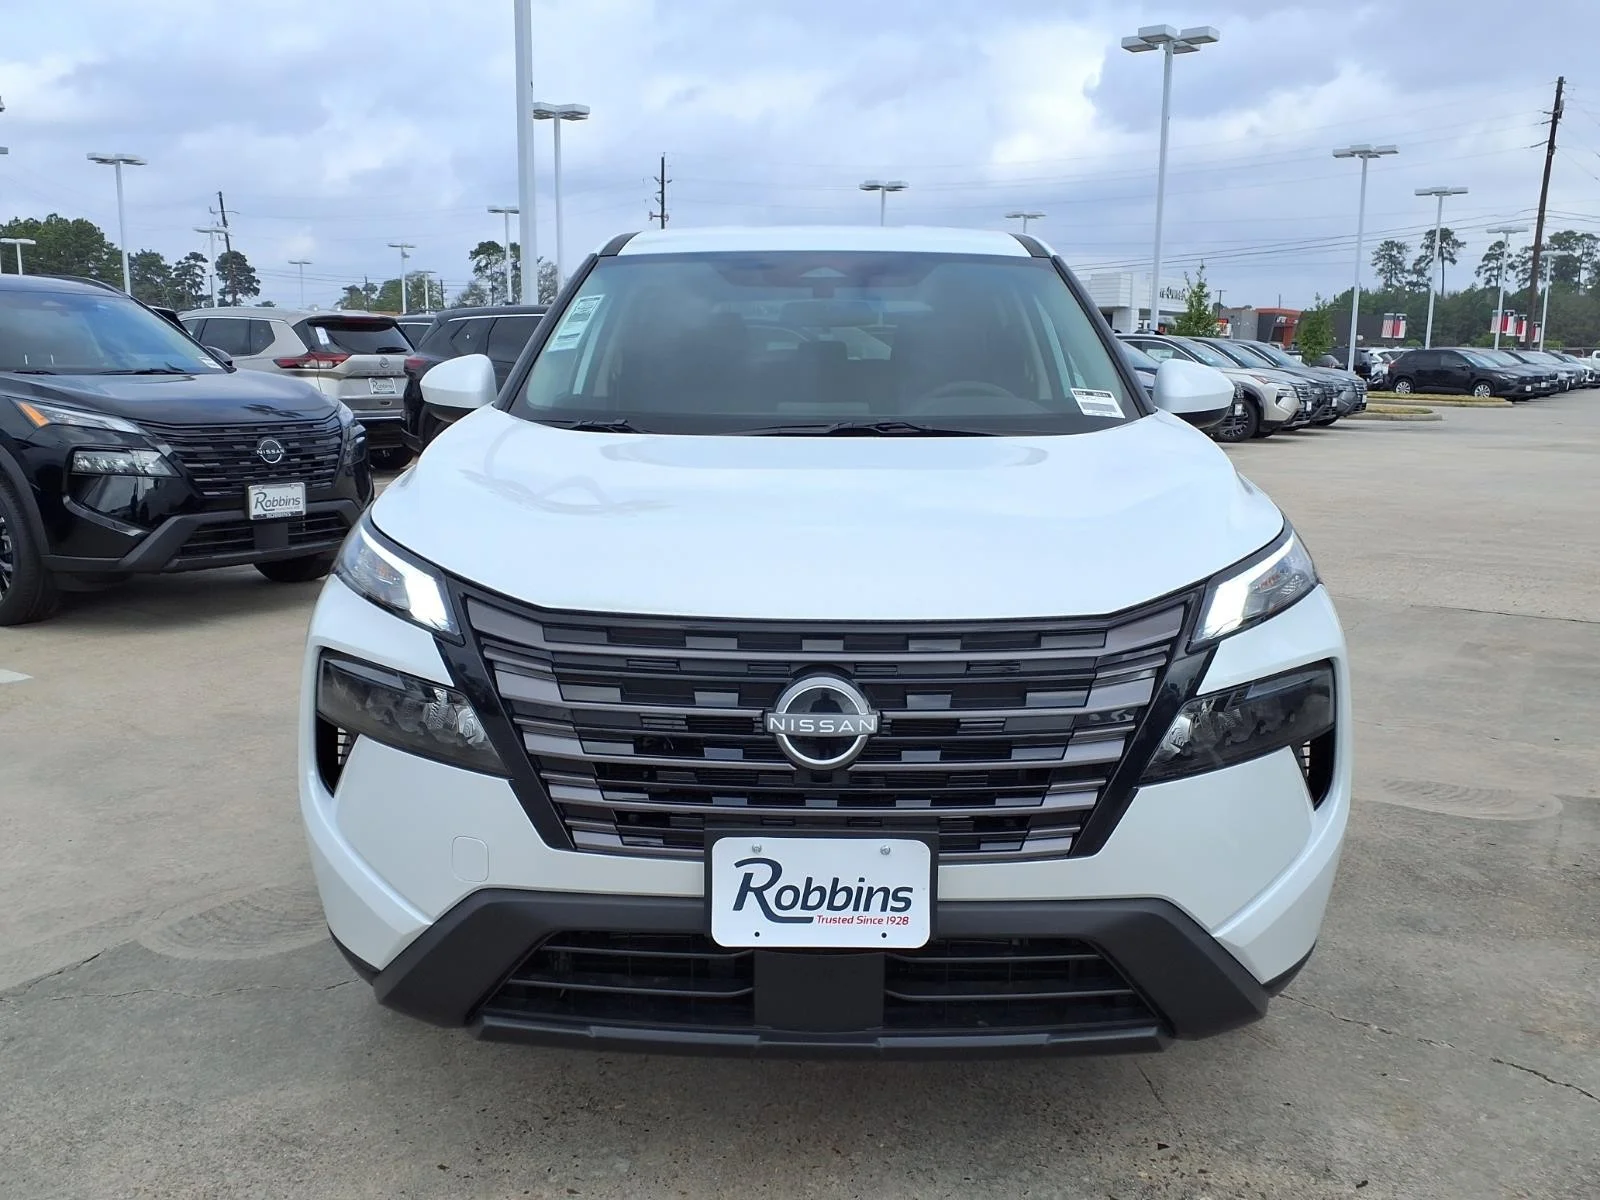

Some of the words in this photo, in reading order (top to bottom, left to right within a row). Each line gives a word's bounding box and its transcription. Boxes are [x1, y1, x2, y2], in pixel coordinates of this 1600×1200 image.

[253, 491, 301, 512] Robbins
[769, 717, 875, 733] NISSAN
[732, 857, 914, 924] Robbins
[816, 914, 854, 925] Trusted
[856, 915, 884, 926] Since
[886, 916, 909, 926] 1928
